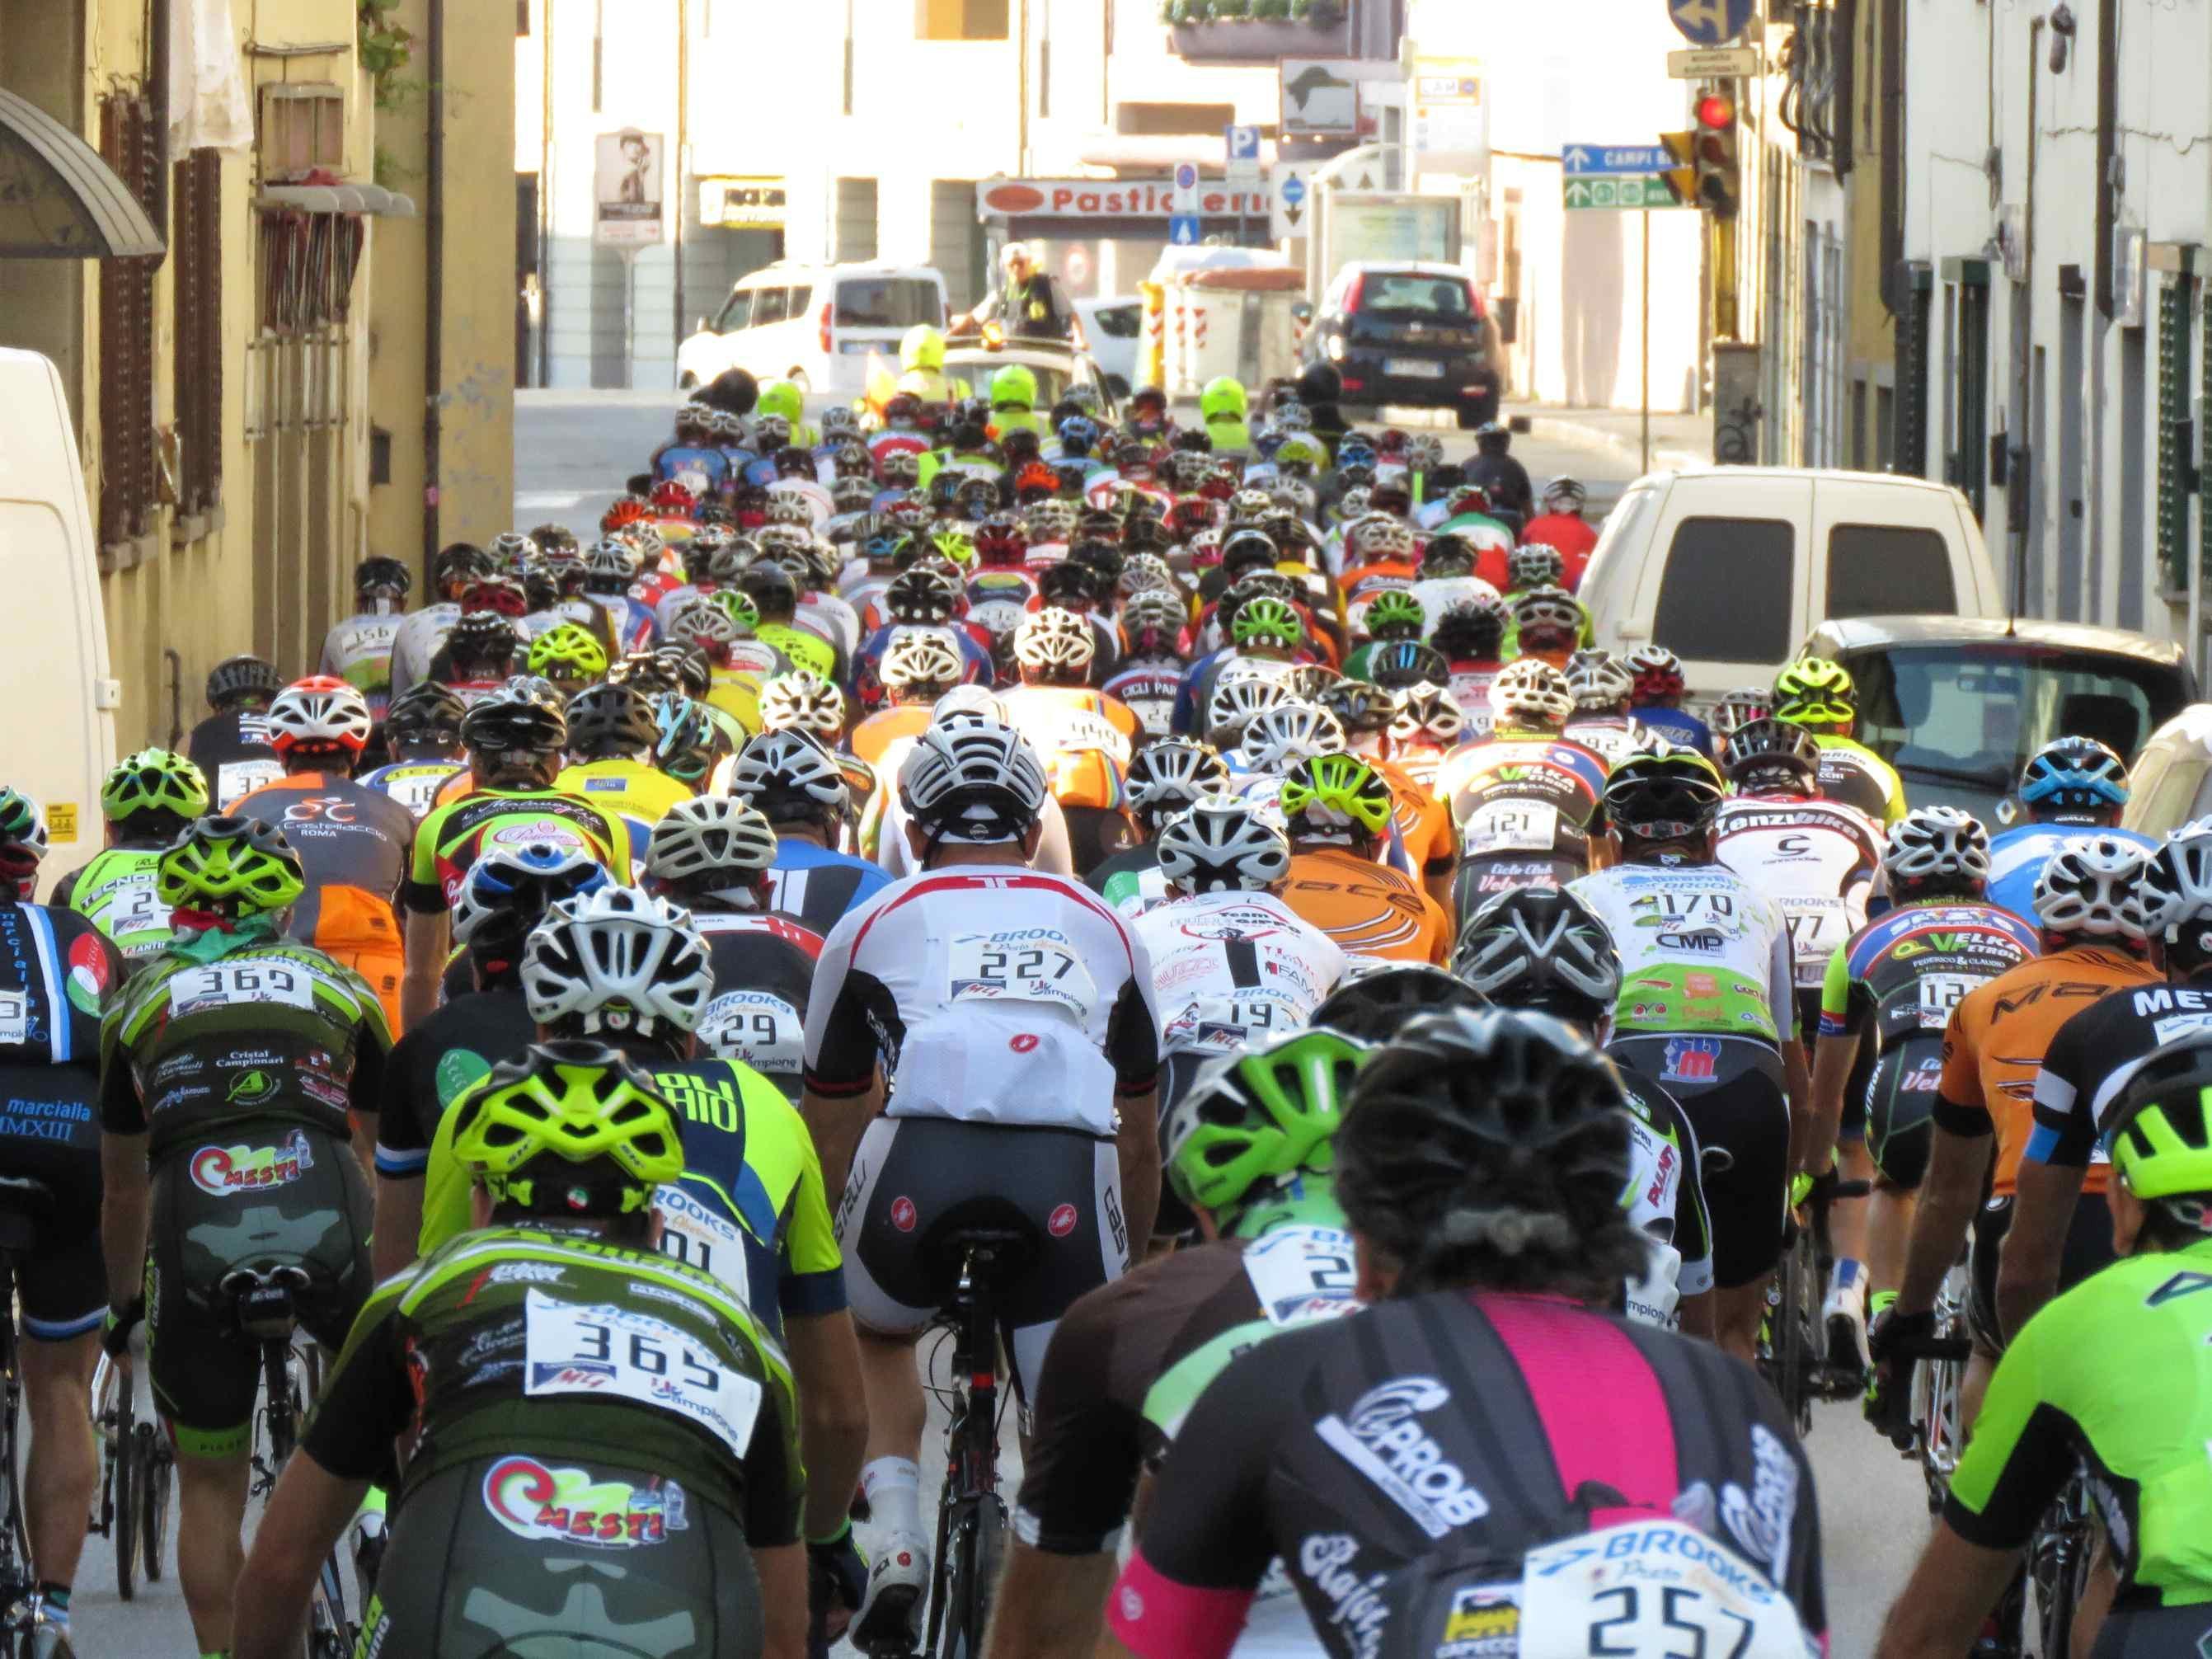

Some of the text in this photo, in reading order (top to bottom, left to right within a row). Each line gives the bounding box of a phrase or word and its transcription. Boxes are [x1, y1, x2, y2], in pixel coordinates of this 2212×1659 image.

[1231, 129, 1252, 157] P
[1604, 151, 1651, 166] CAMPI
[1122, 685, 1150, 698] CICLI
[300, 829, 337, 839] ROMA
[1490, 812, 1530, 834] 121
[1219, 911, 1270, 919] Team
[1662, 894, 1733, 917] 170
[1655, 933, 1724, 952] CMP
[1928, 933, 2022, 956] VELKA
[979, 949, 1075, 980] 227
[1913, 955, 2007, 969] FEDERICO & CLAUDIO
[1233, 988, 1295, 1003] BROO
[720, 1014, 777, 1046] 29
[215, 1056, 284, 1070] Campionari
[229, 1048, 270, 1060] Cristal
[6, 1097, 92, 1123] marcialla
[655, 1187, 735, 1241] ROOKS
[574, 1321, 720, 1393] 365
[1604, 1527, 1774, 1606] BROOKS
[1588, 1584, 1758, 1659] 257
